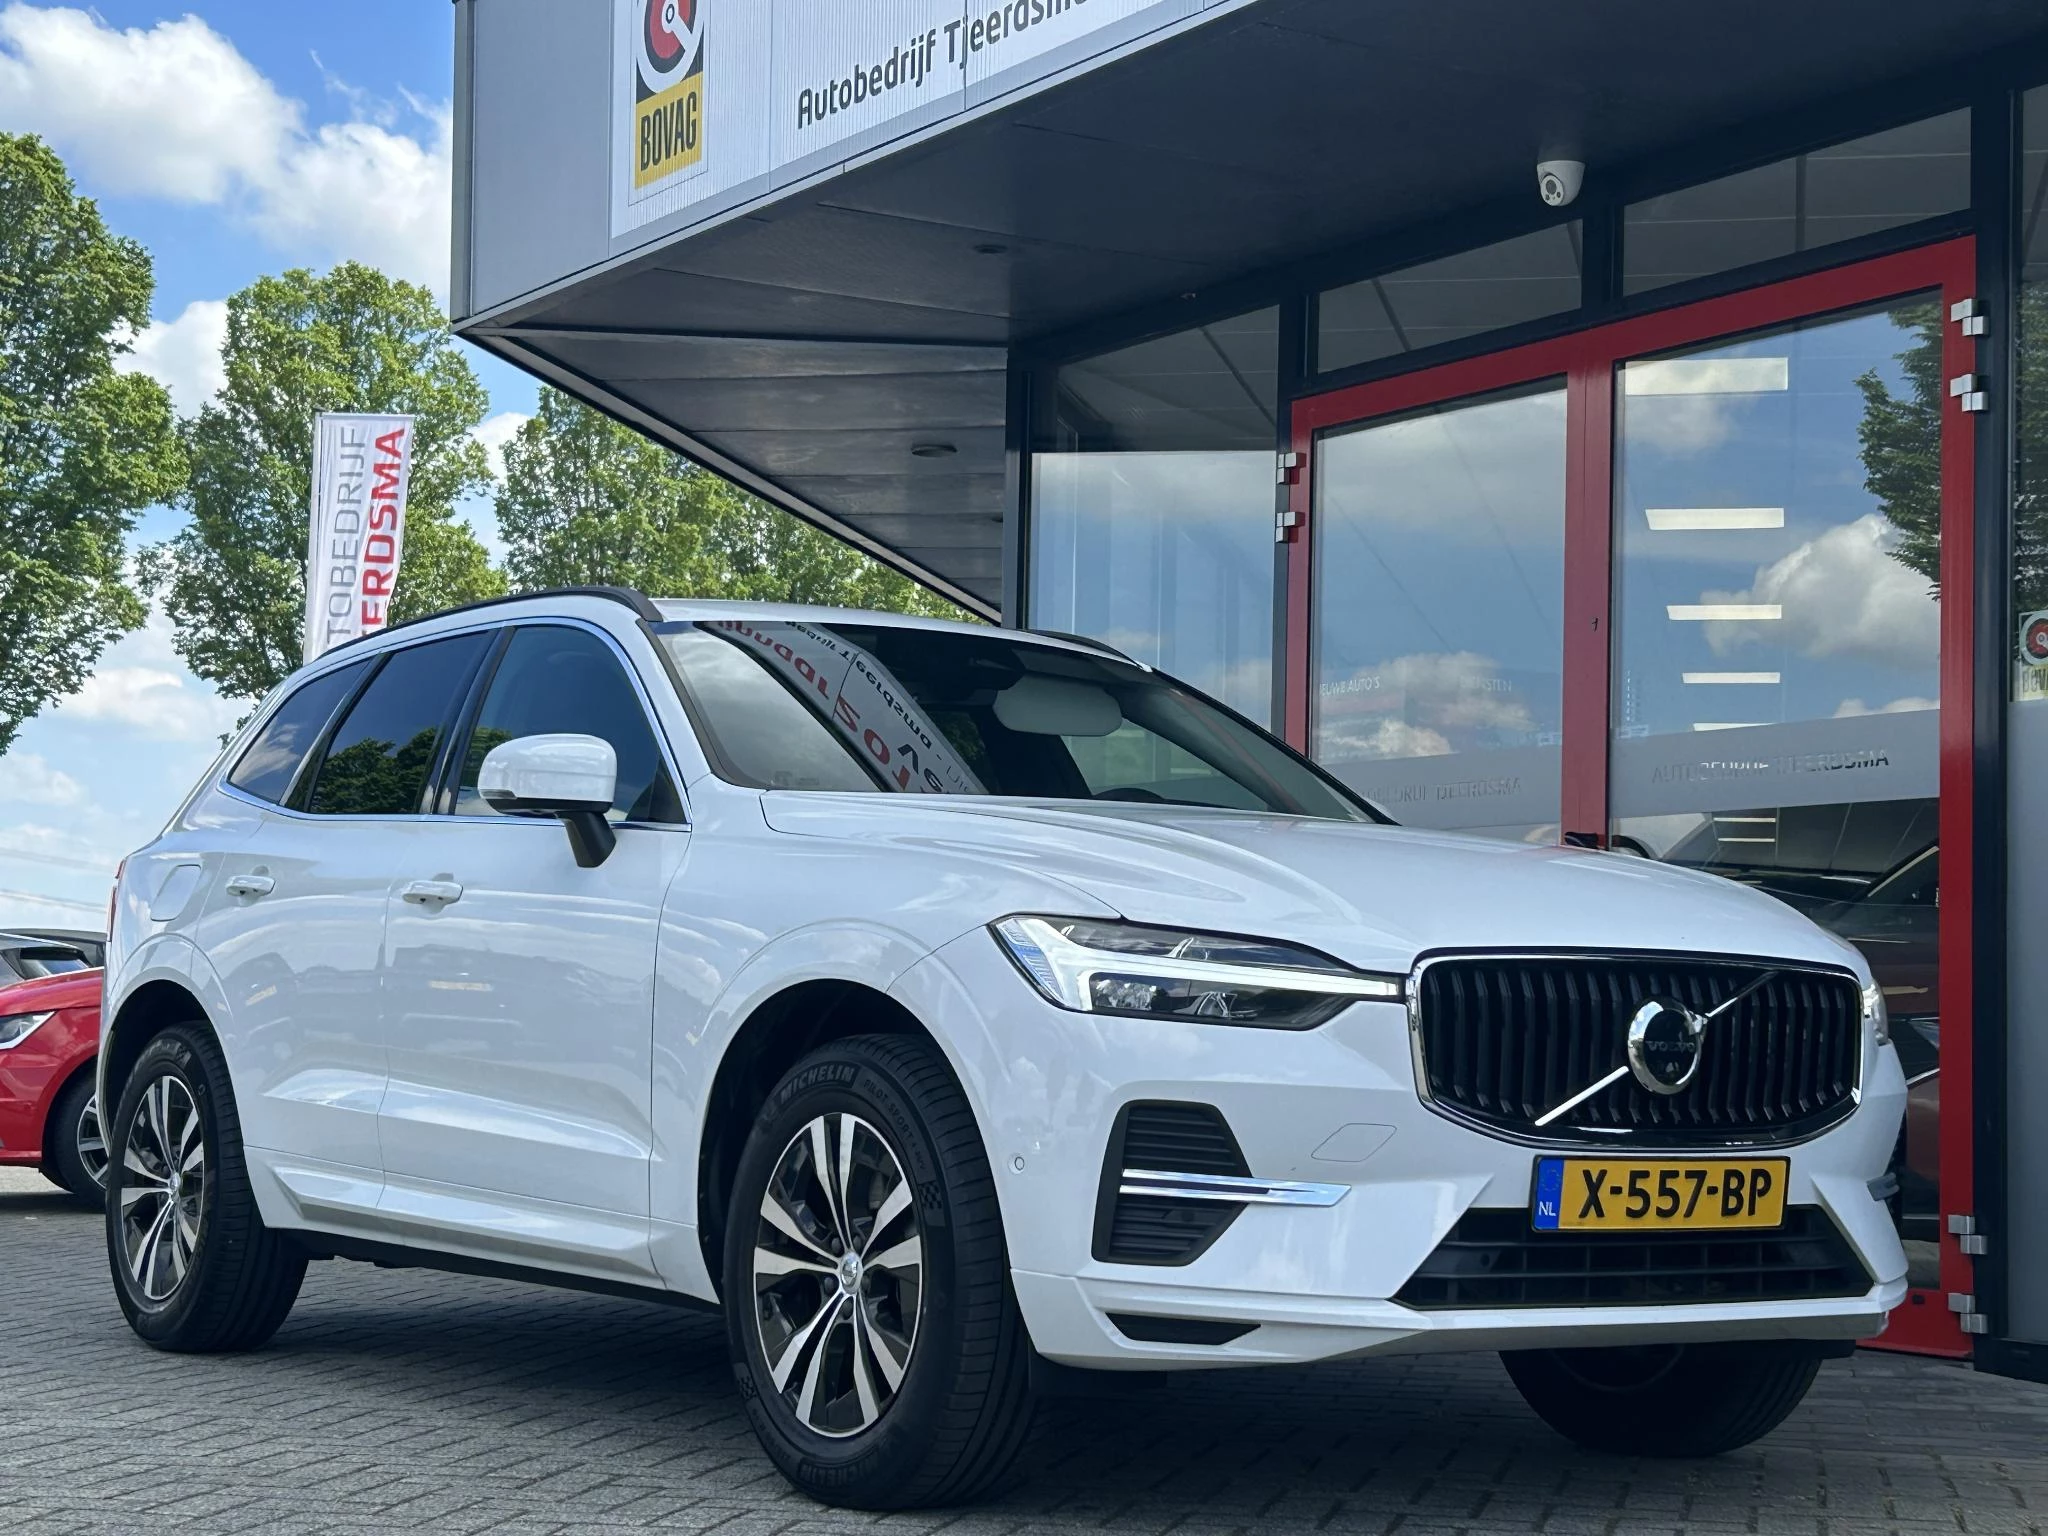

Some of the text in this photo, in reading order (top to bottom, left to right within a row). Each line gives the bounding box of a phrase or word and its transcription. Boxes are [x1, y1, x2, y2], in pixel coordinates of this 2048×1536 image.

[797, 0, 1087, 129] Autobedrijf Tjeerdsm
[640, 91, 697, 172] BOVAG
[361, 427, 405, 636] ERDSMA
[779, 1063, 855, 1105] MICHELIN
[1538, 1201, 1557, 1217] NL
[1578, 1168, 1772, 1219] X-557-BP
